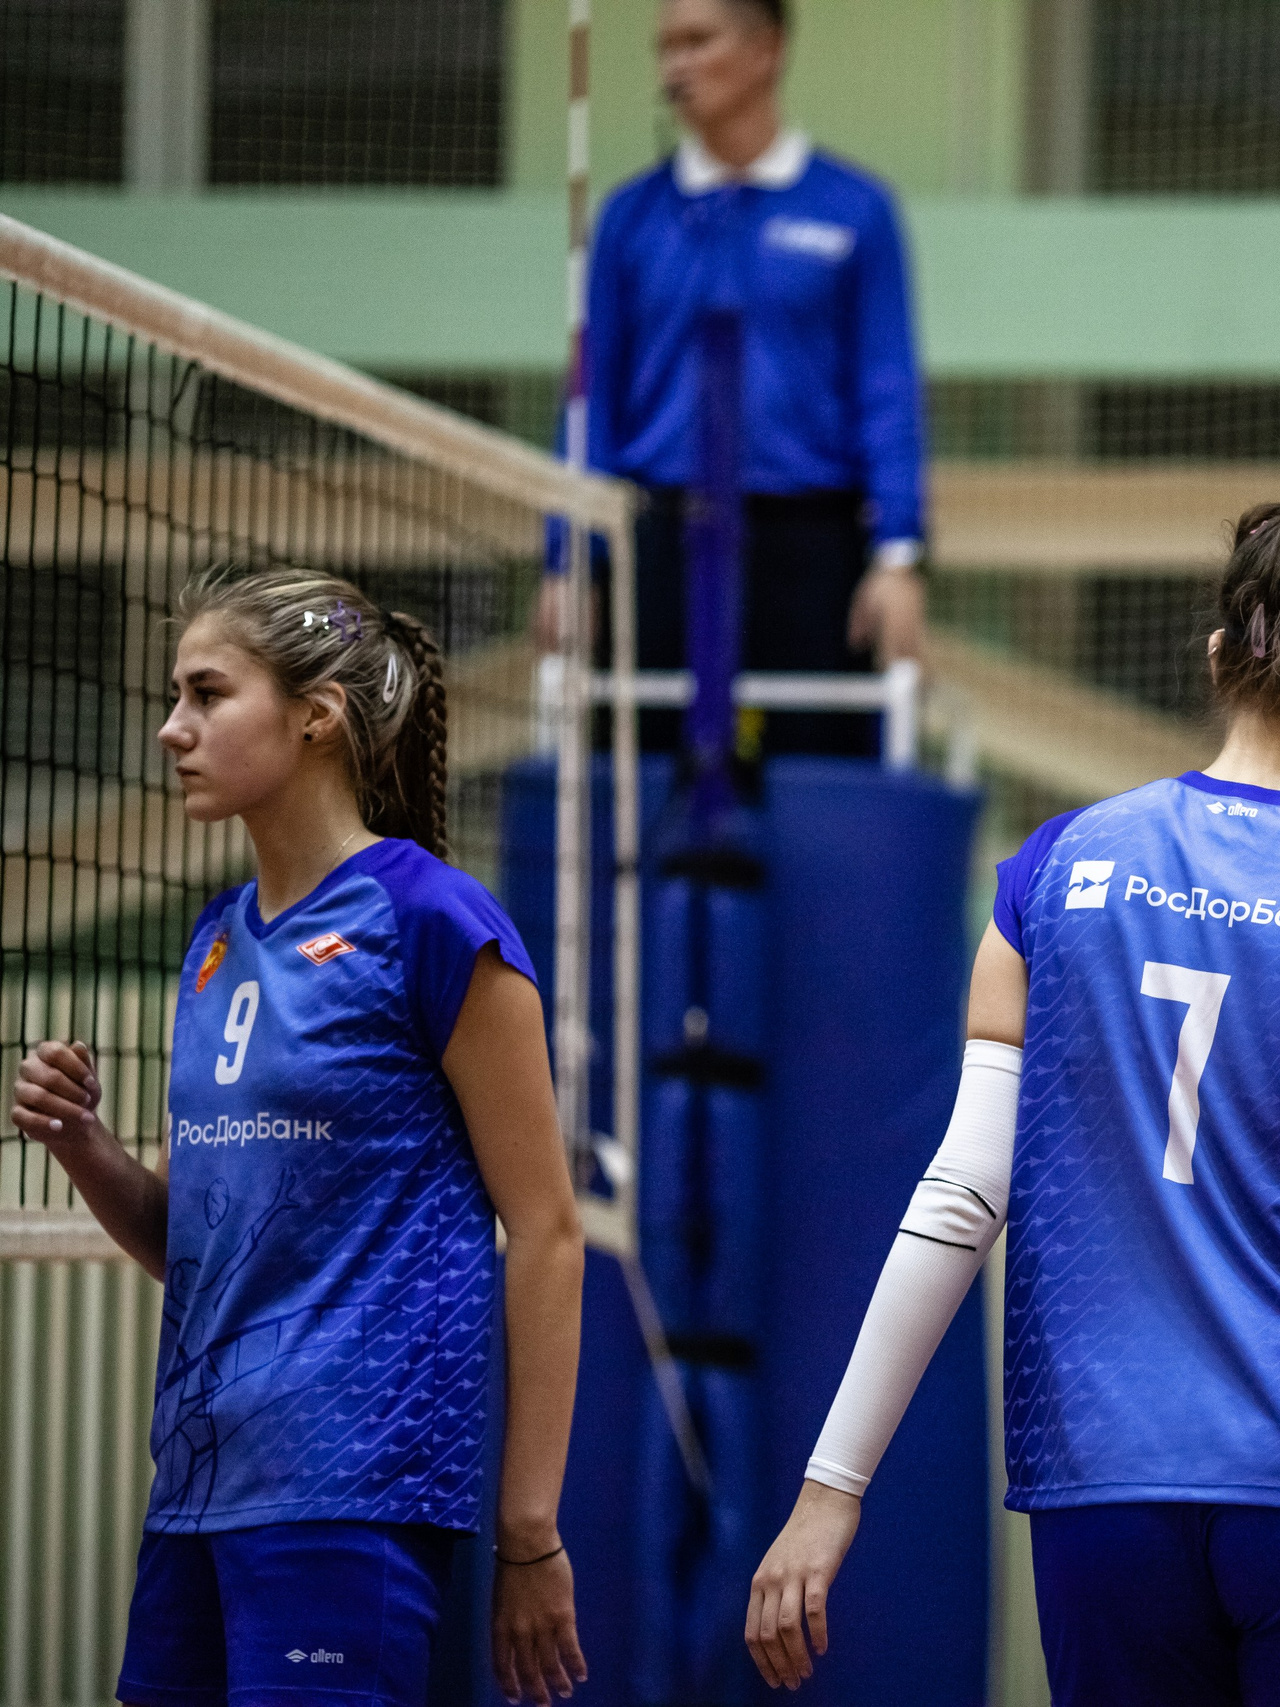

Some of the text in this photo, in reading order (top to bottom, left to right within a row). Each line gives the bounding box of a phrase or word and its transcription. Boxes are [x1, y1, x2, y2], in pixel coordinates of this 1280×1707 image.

[214, 980, 260, 1086] 9
[1139, 960, 1232, 1184] 7
[177, 1112, 334, 1148] РосДорБанк
